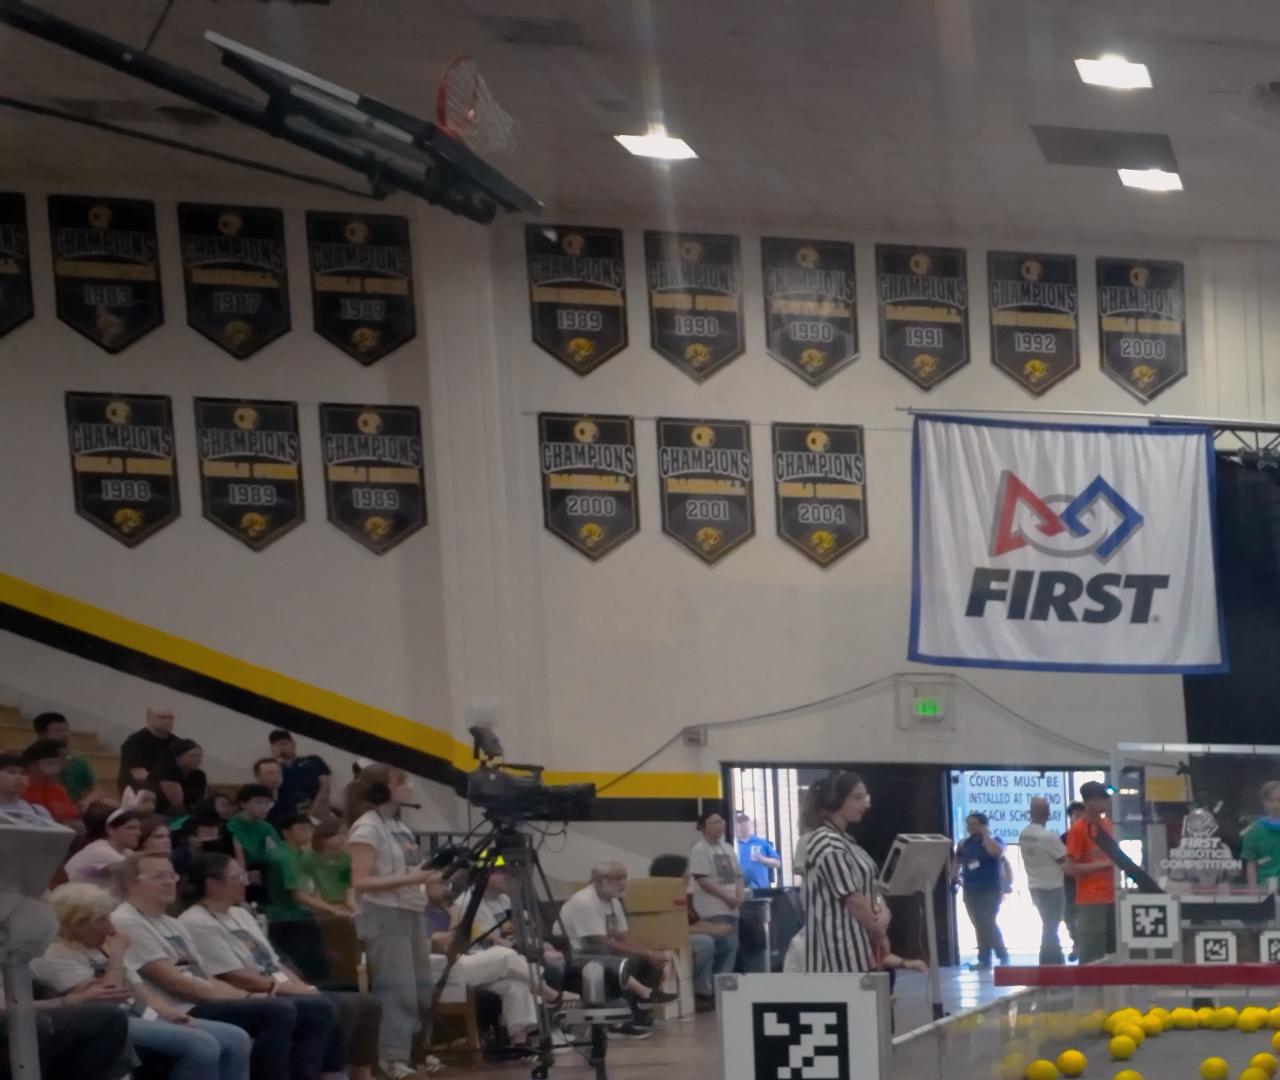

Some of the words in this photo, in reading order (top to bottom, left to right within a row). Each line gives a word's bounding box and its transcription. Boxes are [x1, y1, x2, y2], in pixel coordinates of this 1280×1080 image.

[880, 274, 966, 309] CHAMPIONS
[992, 280, 1077, 314] CHAMPIONS
[556, 309, 603, 331] 1989
[675, 315, 719, 337] 1990
[790, 320, 833, 343] 1990
[905, 326, 944, 348] 1991
[1013, 332, 1056, 354] 1992
[1120, 338, 1165, 360] 2000
[71, 423, 174, 460] CHAMPIONS
[200, 428, 299, 463] CHAMPIONS
[325, 433, 421, 467] CHAMPIONS
[542, 443, 636, 477] CHAMPIONS
[659, 447, 751, 479] CHAMPIONS
[775, 451, 864, 484] CHAMPIONS
[100, 479, 151, 501] 1988
[228, 483, 277, 505] 1989
[352, 488, 400, 509] 1989
[566, 495, 616, 516] 2000
[686, 500, 729, 520] 2001
[798, 504, 846, 524] 2004
[964, 567, 1170, 624] FIRST
[969, 774, 1008, 787] COVERS
[1014, 776, 1041, 787] MUST
[1047, 776, 1059, 787] BE
[968, 793, 1010, 804] INSTALLED
[1014, 793, 1023, 804] AT
[1170, 849, 1231, 859] ROBOTICS
[1180, 837, 1222, 849] FIRST
[1160, 859, 1242, 870] COMPETITION
